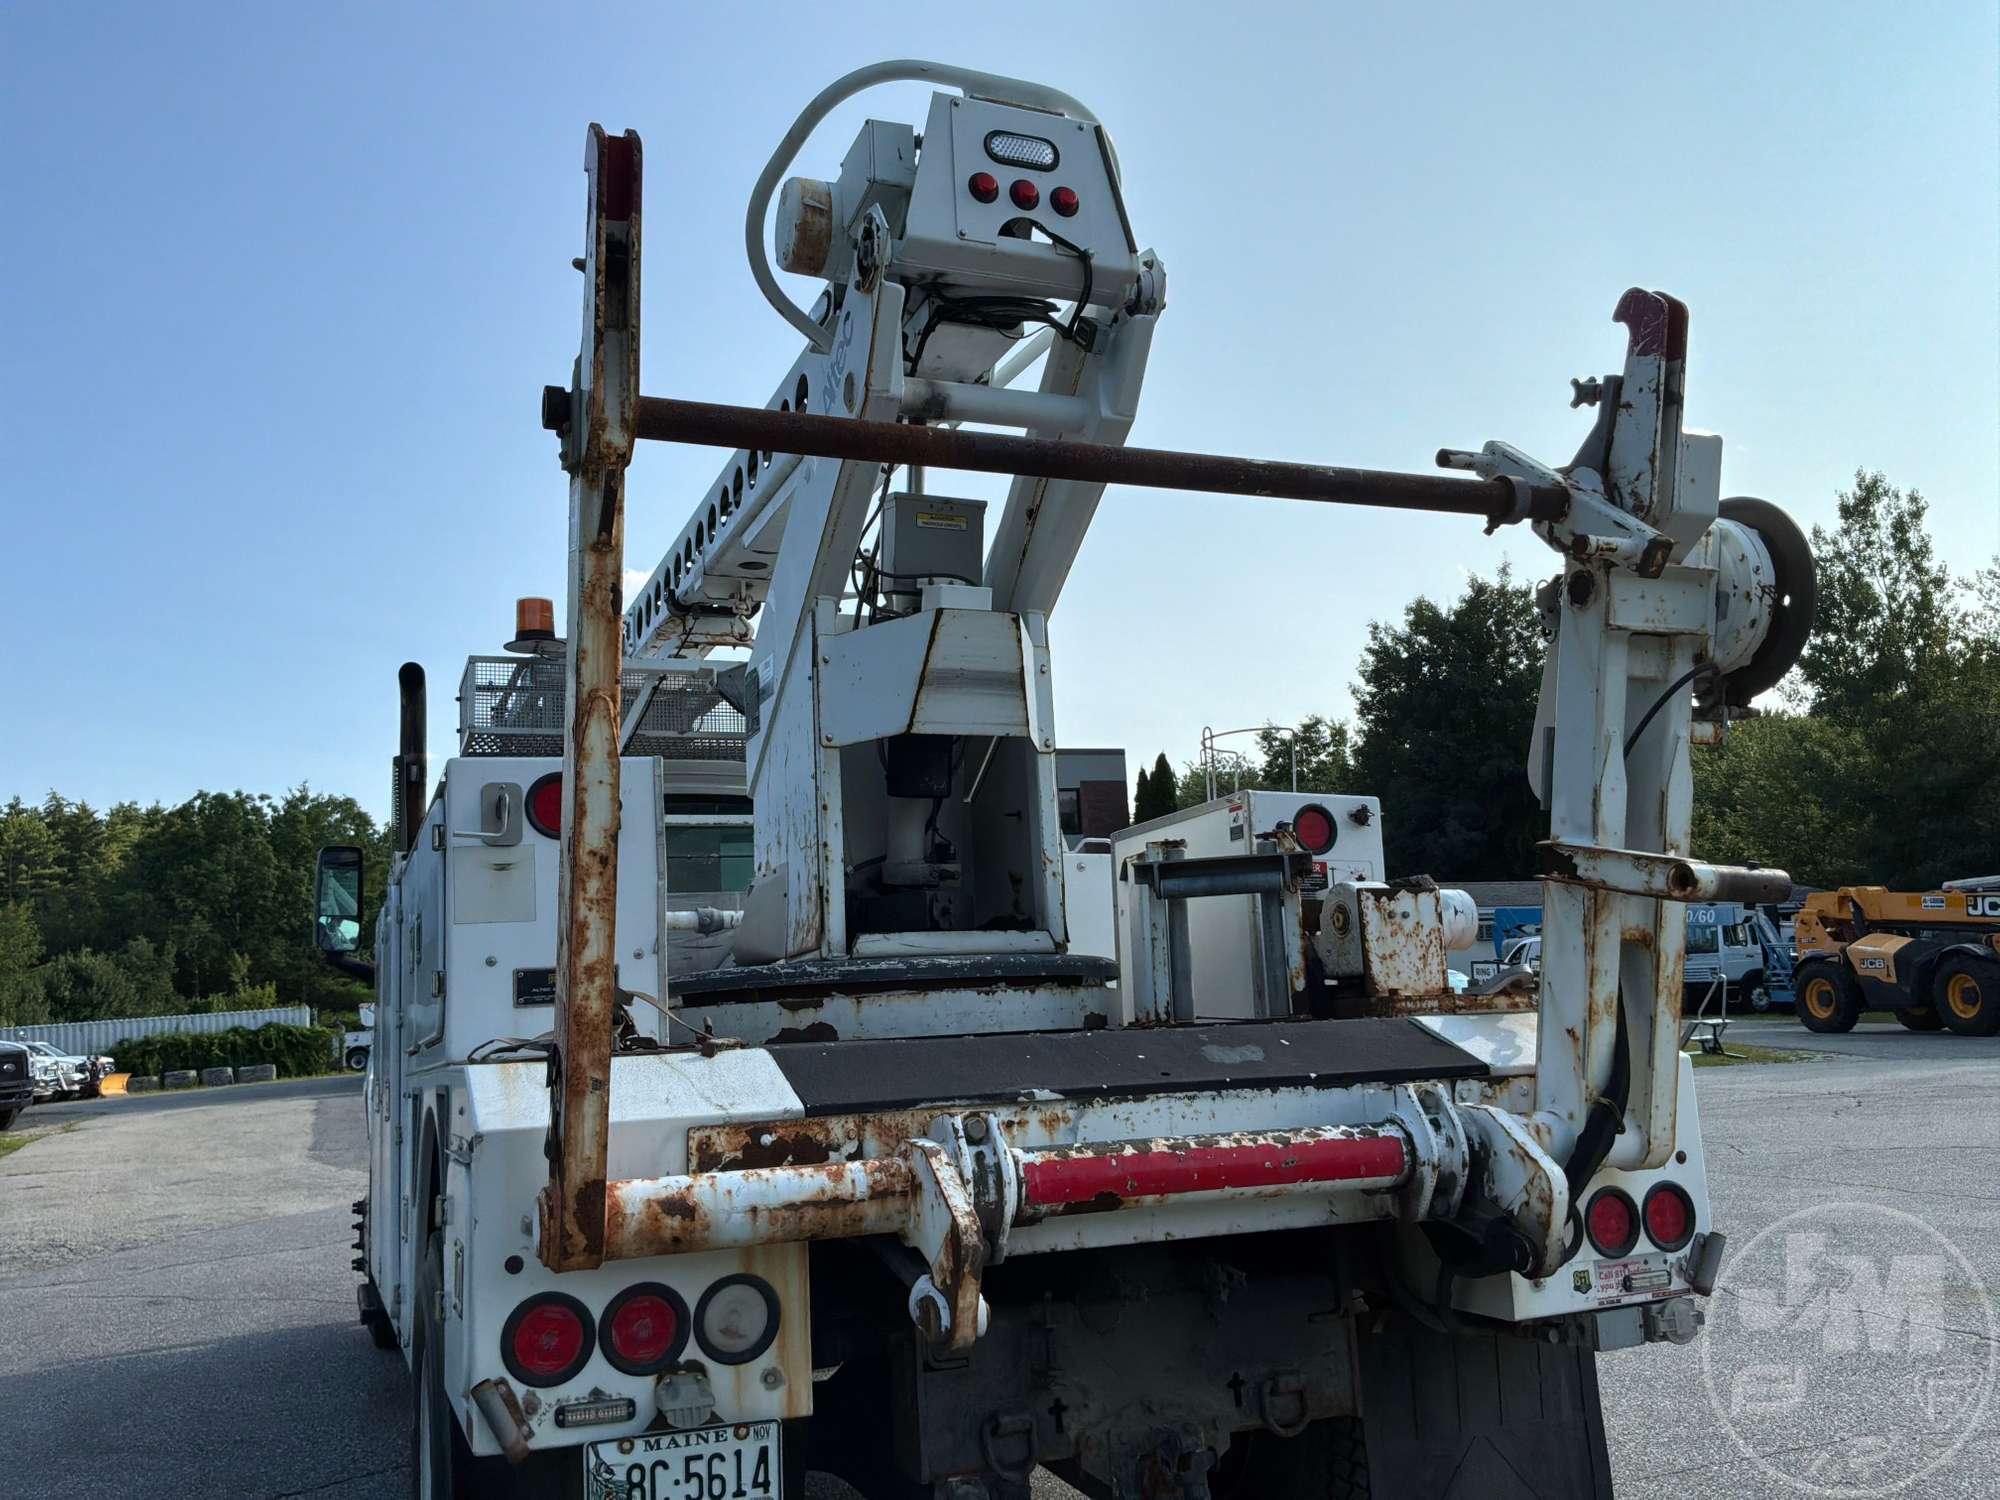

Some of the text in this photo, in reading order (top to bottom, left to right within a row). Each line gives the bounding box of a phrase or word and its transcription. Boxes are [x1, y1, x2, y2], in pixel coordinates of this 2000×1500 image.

[1860, 958, 1885, 969] JCB
[643, 1426, 771, 1453] MAINE NOV
